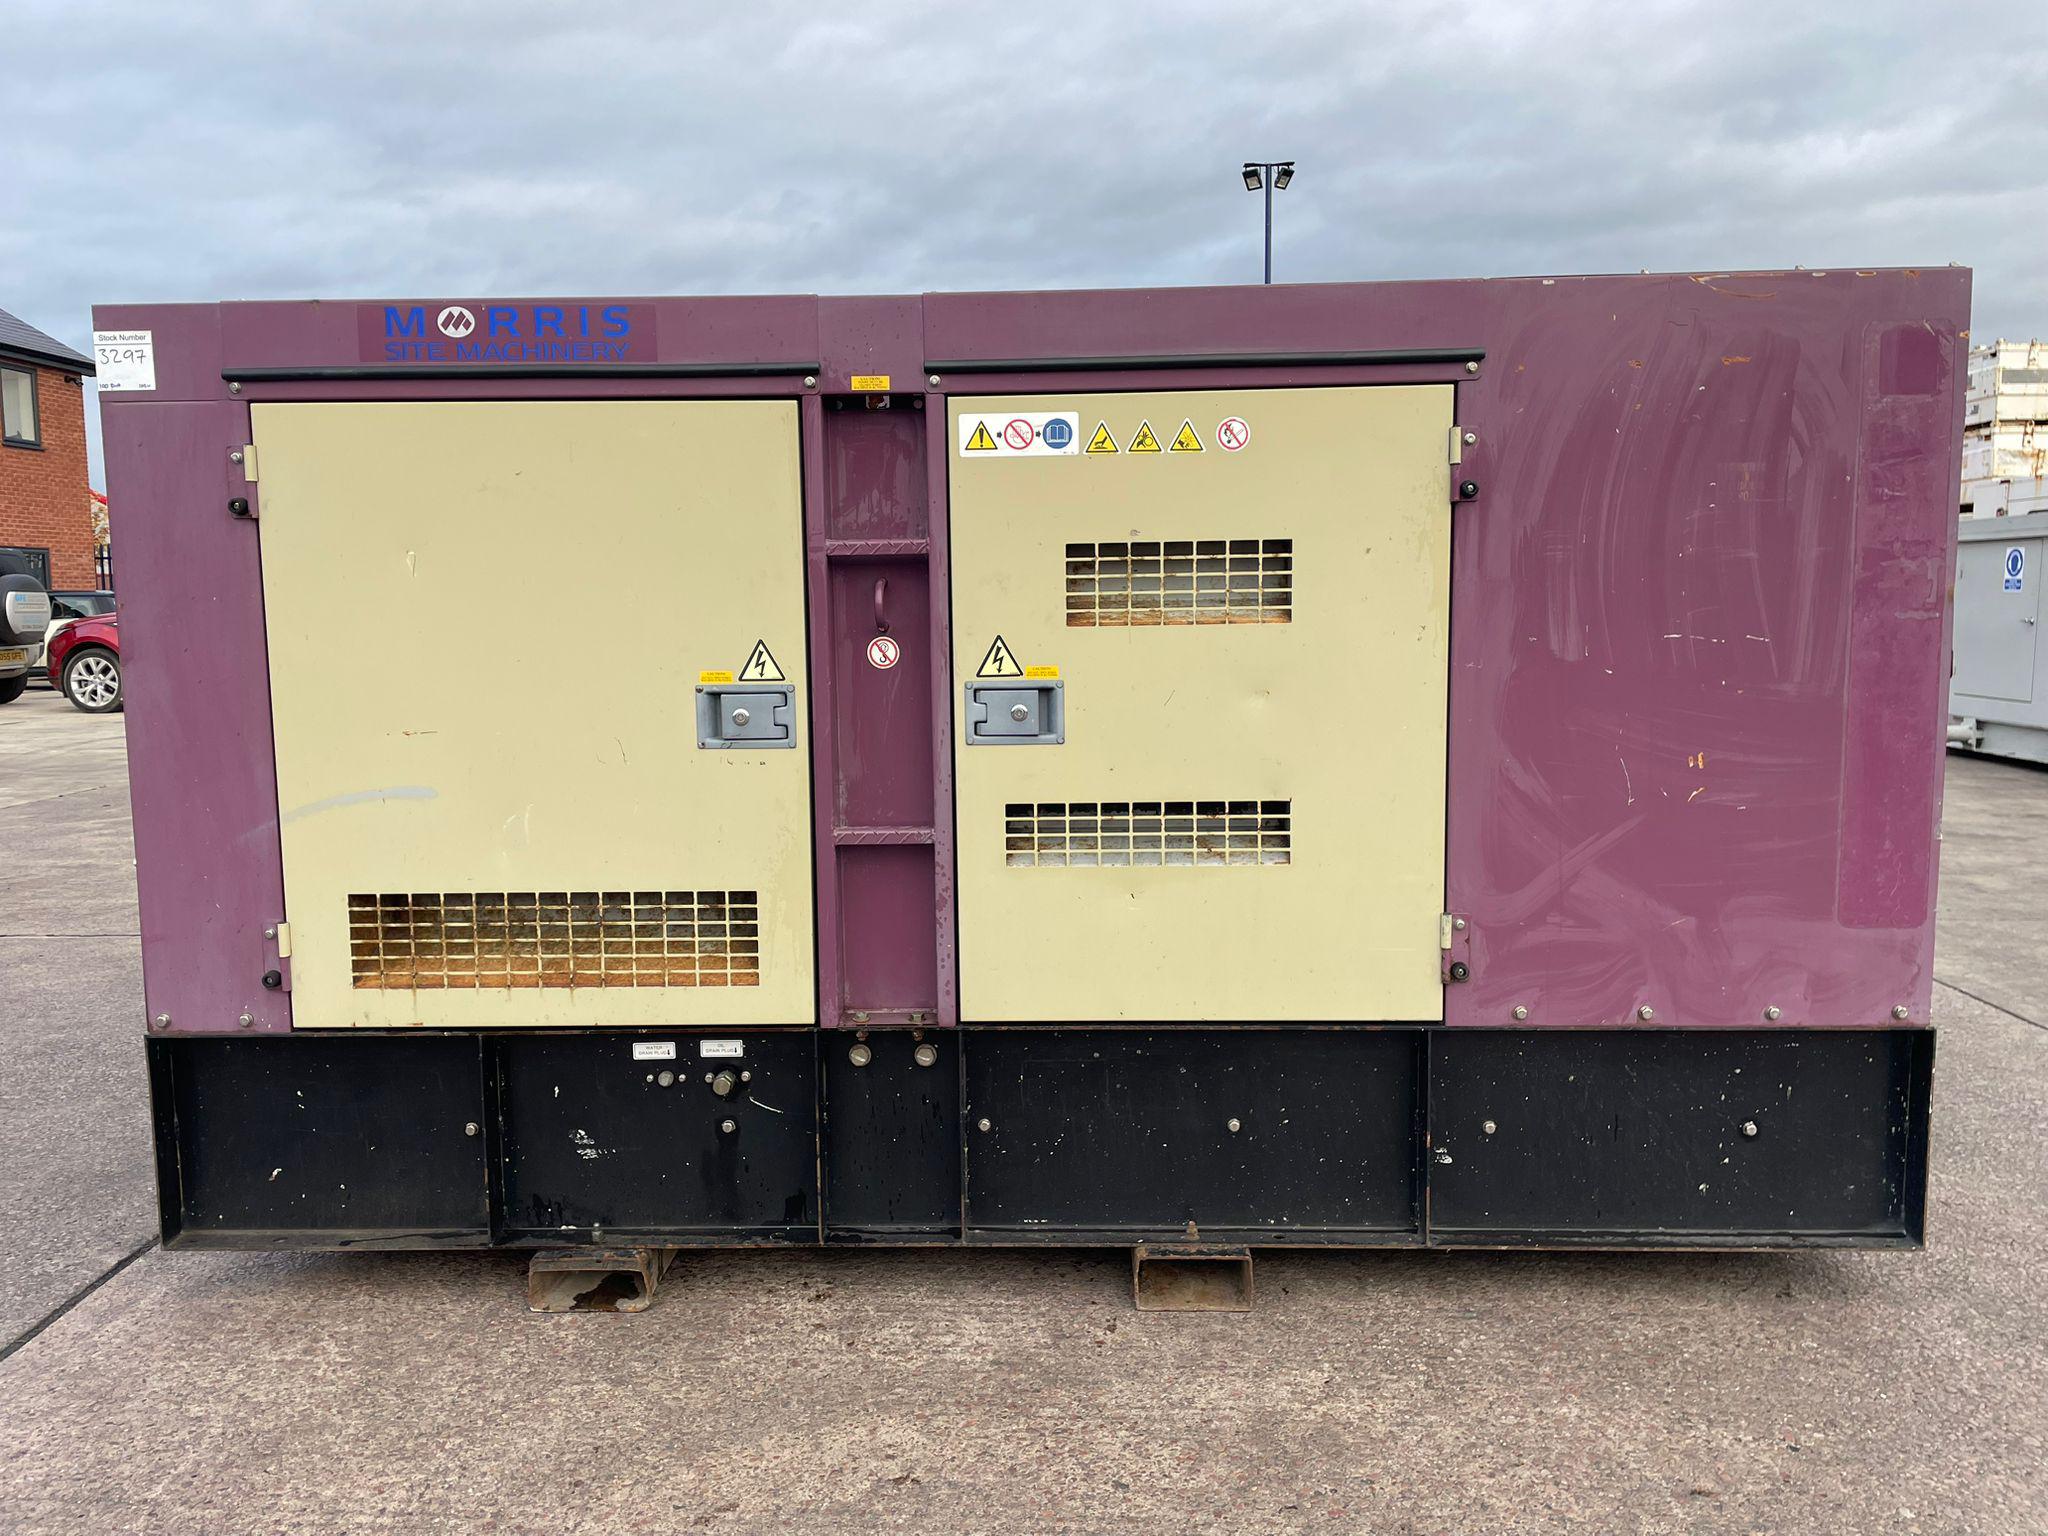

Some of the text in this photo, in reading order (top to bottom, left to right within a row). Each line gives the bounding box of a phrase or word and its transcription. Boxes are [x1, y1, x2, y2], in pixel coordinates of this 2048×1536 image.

[384, 305, 631, 338] MORRIS
[98, 348, 147, 365] 3297
[384, 341, 631, 361] SITE MACHINERY
